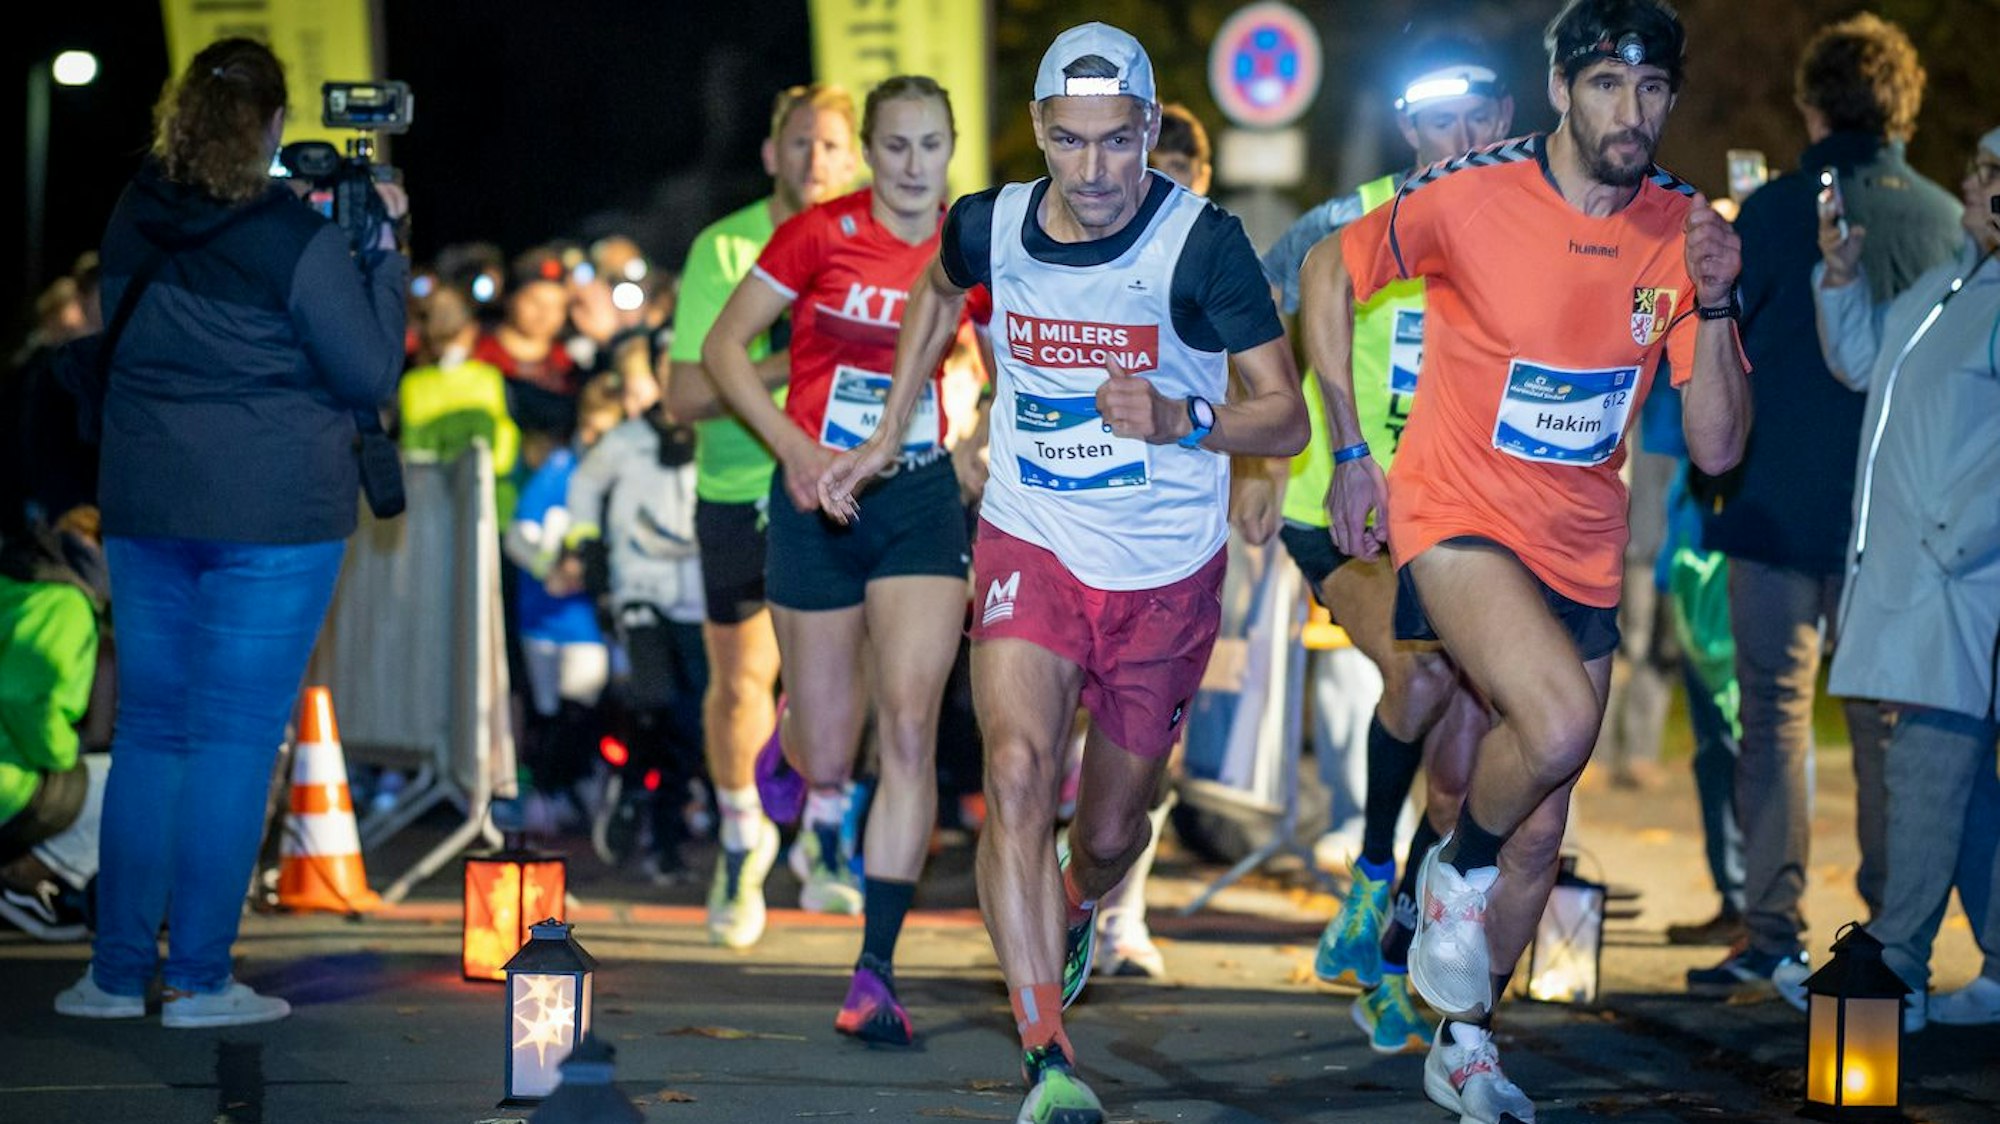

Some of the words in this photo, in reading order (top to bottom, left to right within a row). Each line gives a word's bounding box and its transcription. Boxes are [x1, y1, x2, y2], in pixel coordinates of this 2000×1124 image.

[1569, 239, 1619, 258] hummel
[841, 282, 909, 326] KT
[1039, 322, 1129, 347] MILERS
[1602, 391, 1627, 410] 612
[1535, 412, 1601, 433] Hakim
[1034, 440, 1114, 460] Torsten
